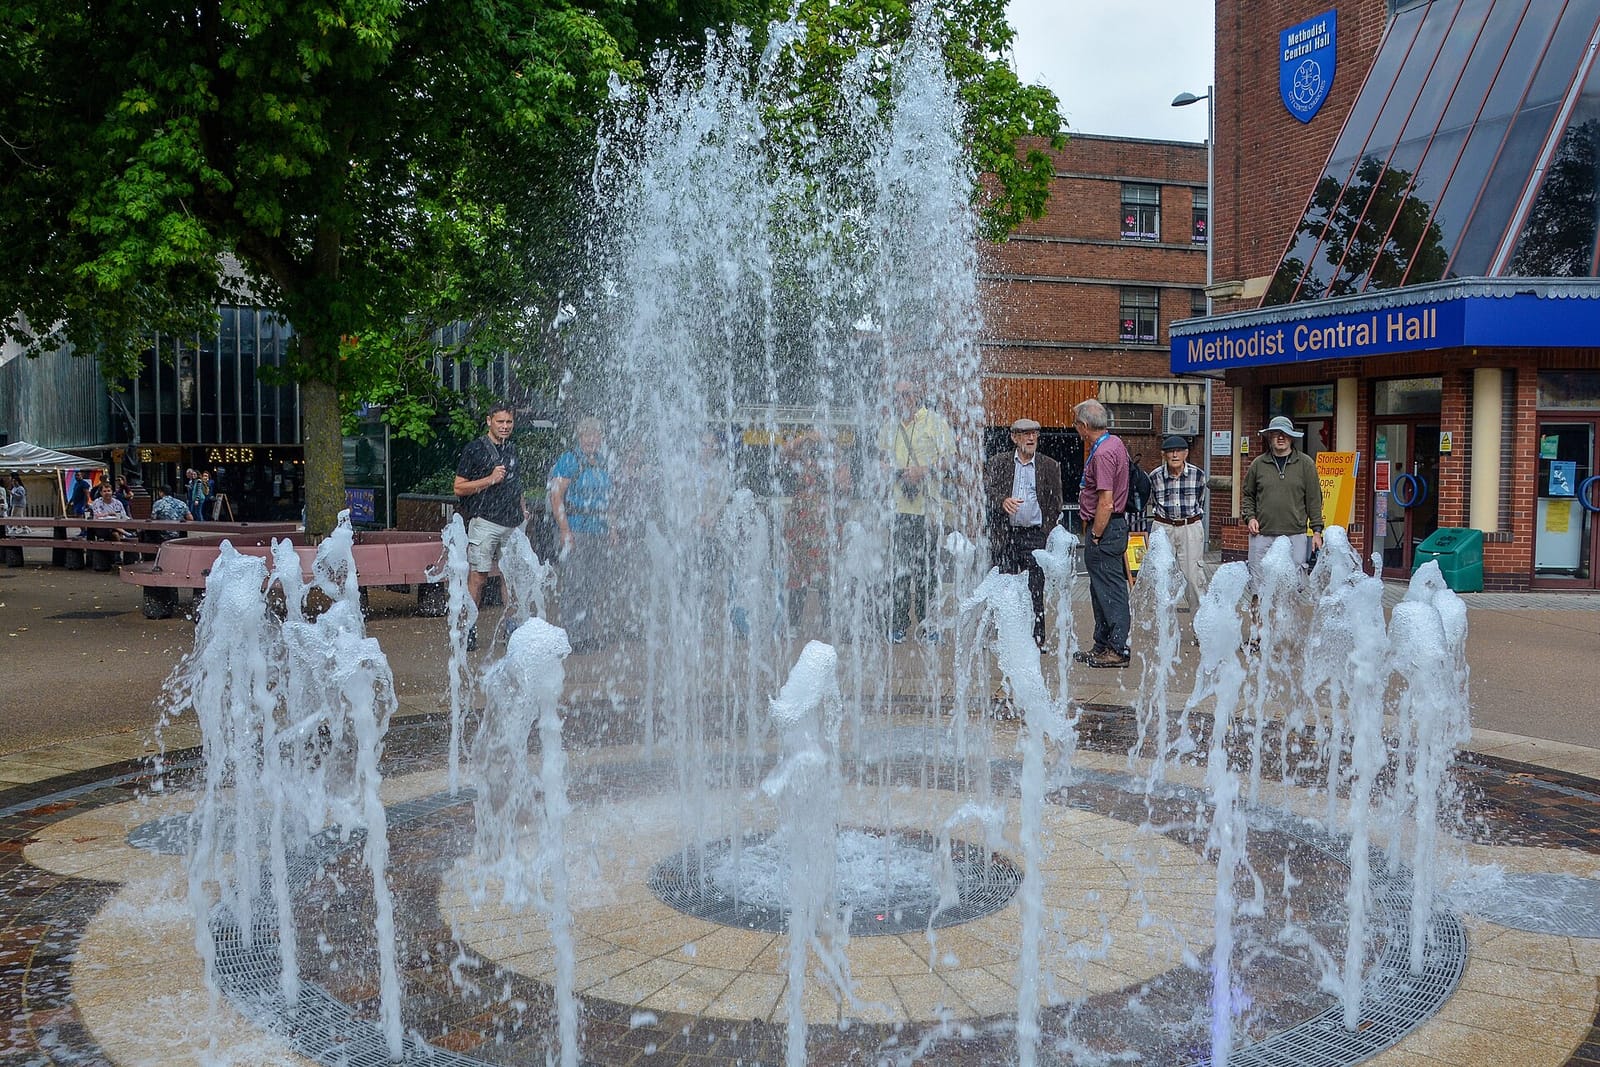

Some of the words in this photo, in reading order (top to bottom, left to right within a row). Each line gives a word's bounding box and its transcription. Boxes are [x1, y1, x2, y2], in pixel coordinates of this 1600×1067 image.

[1284, 40, 1312, 62] Central
[1314, 33, 1330, 50] Hall
[1288, 20, 1326, 47] Methodist
[1187, 328, 1284, 364] Methodist
[1293, 316, 1377, 352] Central
[1387, 308, 1437, 342] Hall
[1317, 454, 1343, 463] Stories
[1345, 453, 1354, 463] of
